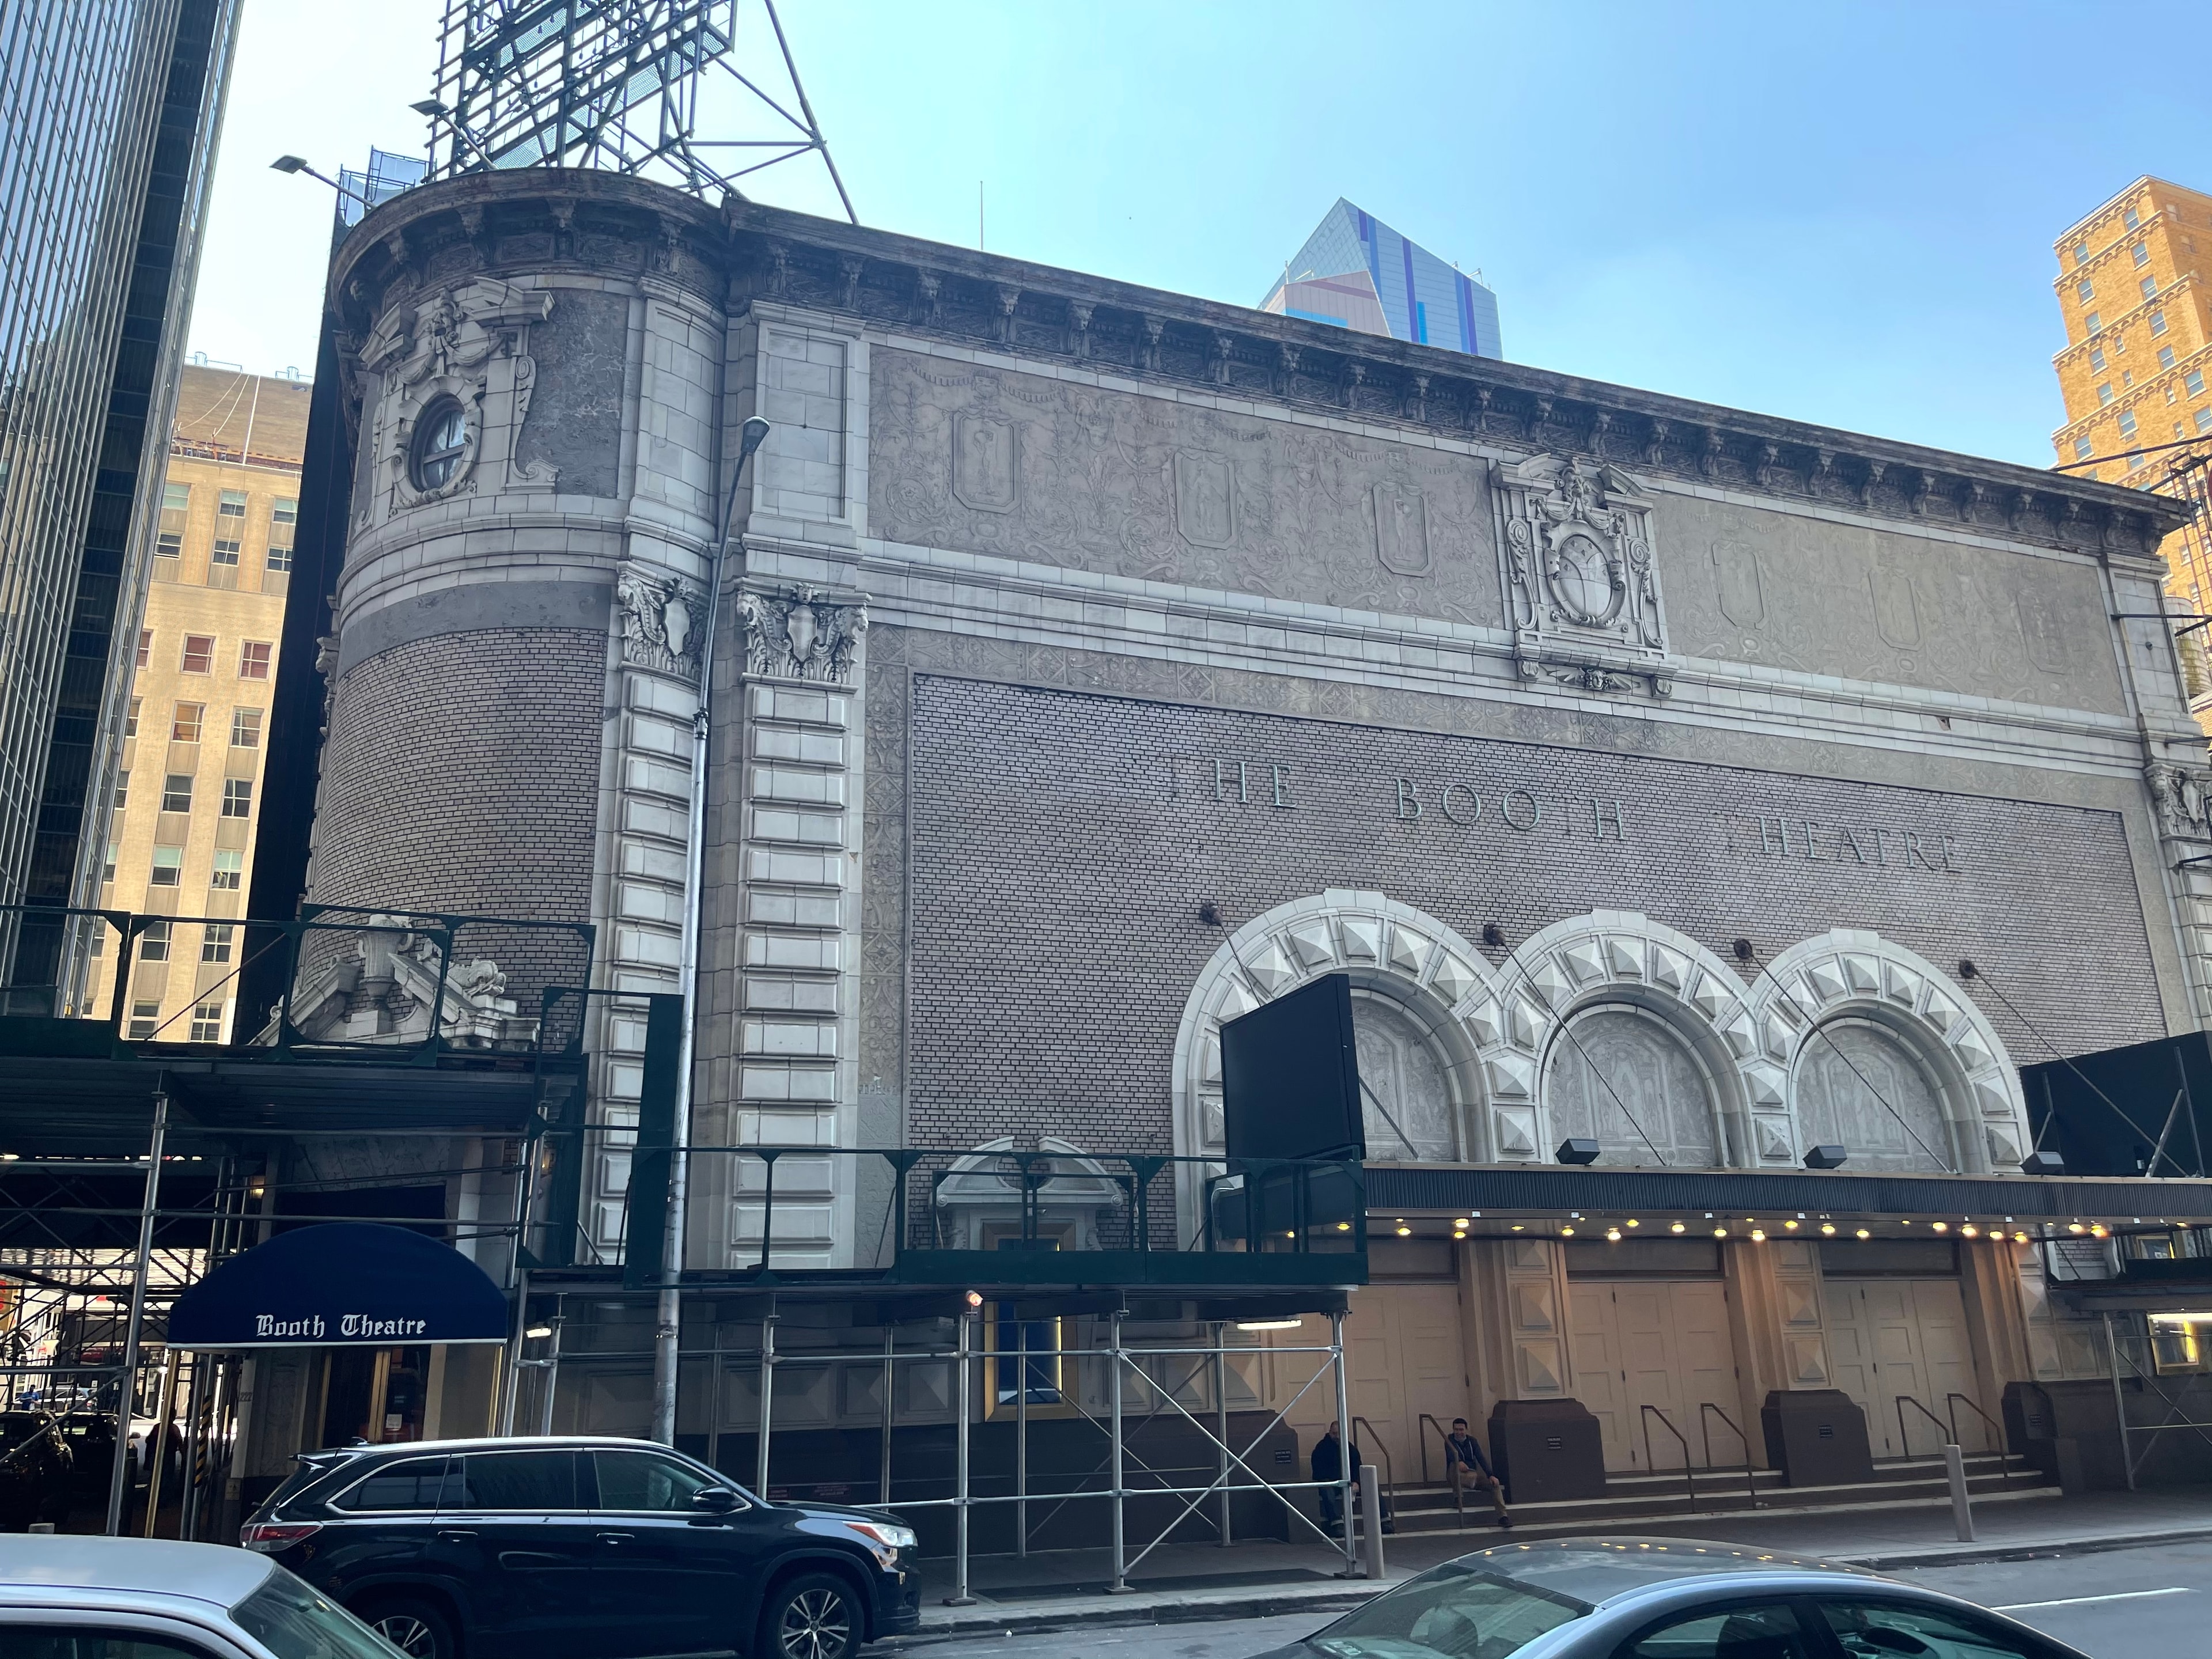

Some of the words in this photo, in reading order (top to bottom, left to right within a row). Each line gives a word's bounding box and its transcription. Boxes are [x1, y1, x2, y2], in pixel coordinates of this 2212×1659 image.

[1719, 813, 1965, 873] HEATRE
[256, 1314, 325, 1338] Booth
[340, 1314, 426, 1338] Theatre
